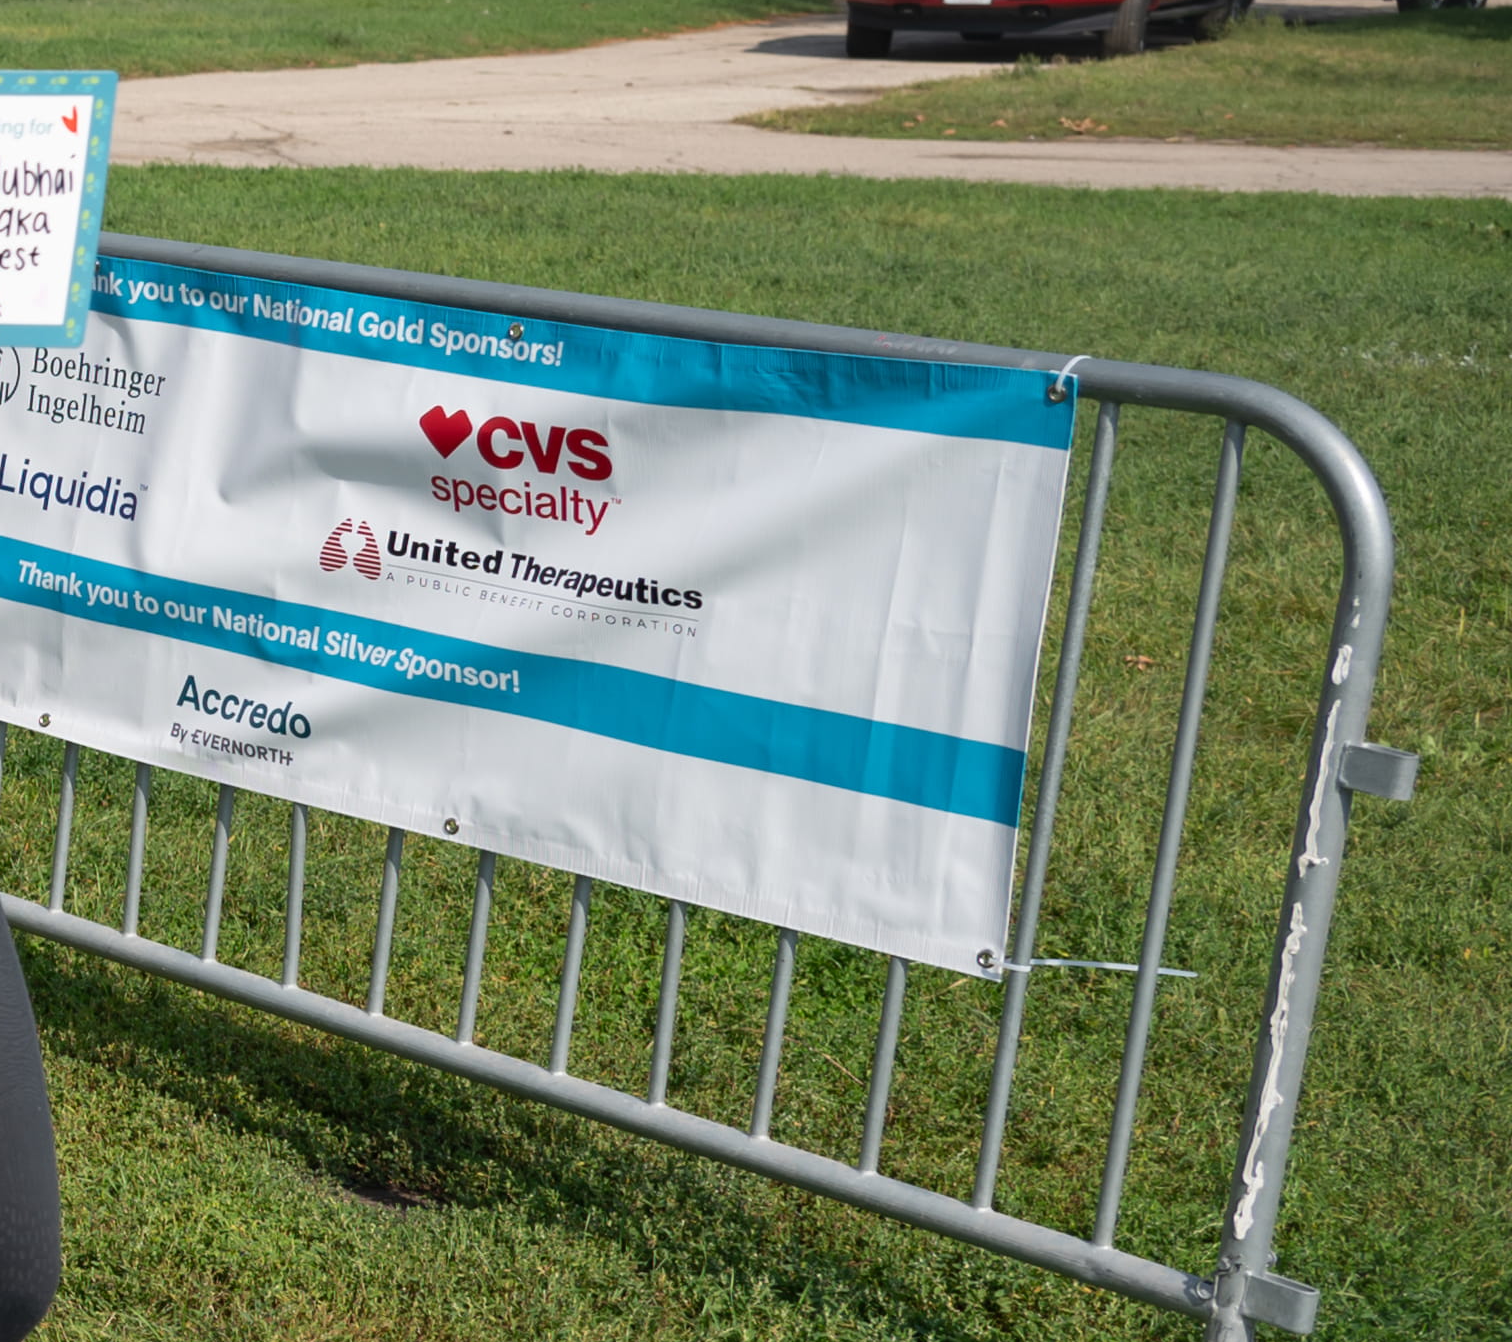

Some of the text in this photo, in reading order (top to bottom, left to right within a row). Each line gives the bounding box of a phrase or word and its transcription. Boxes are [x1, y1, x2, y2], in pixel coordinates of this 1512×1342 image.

[30, 118, 54, 135] for
[127, 279, 174, 304] you
[179, 283, 205, 307] to
[209, 291, 248, 315] our
[253, 293, 354, 334] National
[358, 311, 425, 345] Gold
[429, 322, 564, 367] Sponsors!
[31, 347, 166, 399] Boehringer
[26, 384, 146, 435] Ingelheim
[477, 416, 613, 481] CVS
[431, 475, 609, 535] specialty
[387, 531, 703, 609] United Therapeutics
[18, 559, 520, 693] Thank you to our National Silver Sponsor!
[385, 572, 698, 638] A PUBLIC BENEFIT CORPORATION
[176, 674, 312, 739] Accredo
[170, 722, 294, 766] By EVERNORTH
